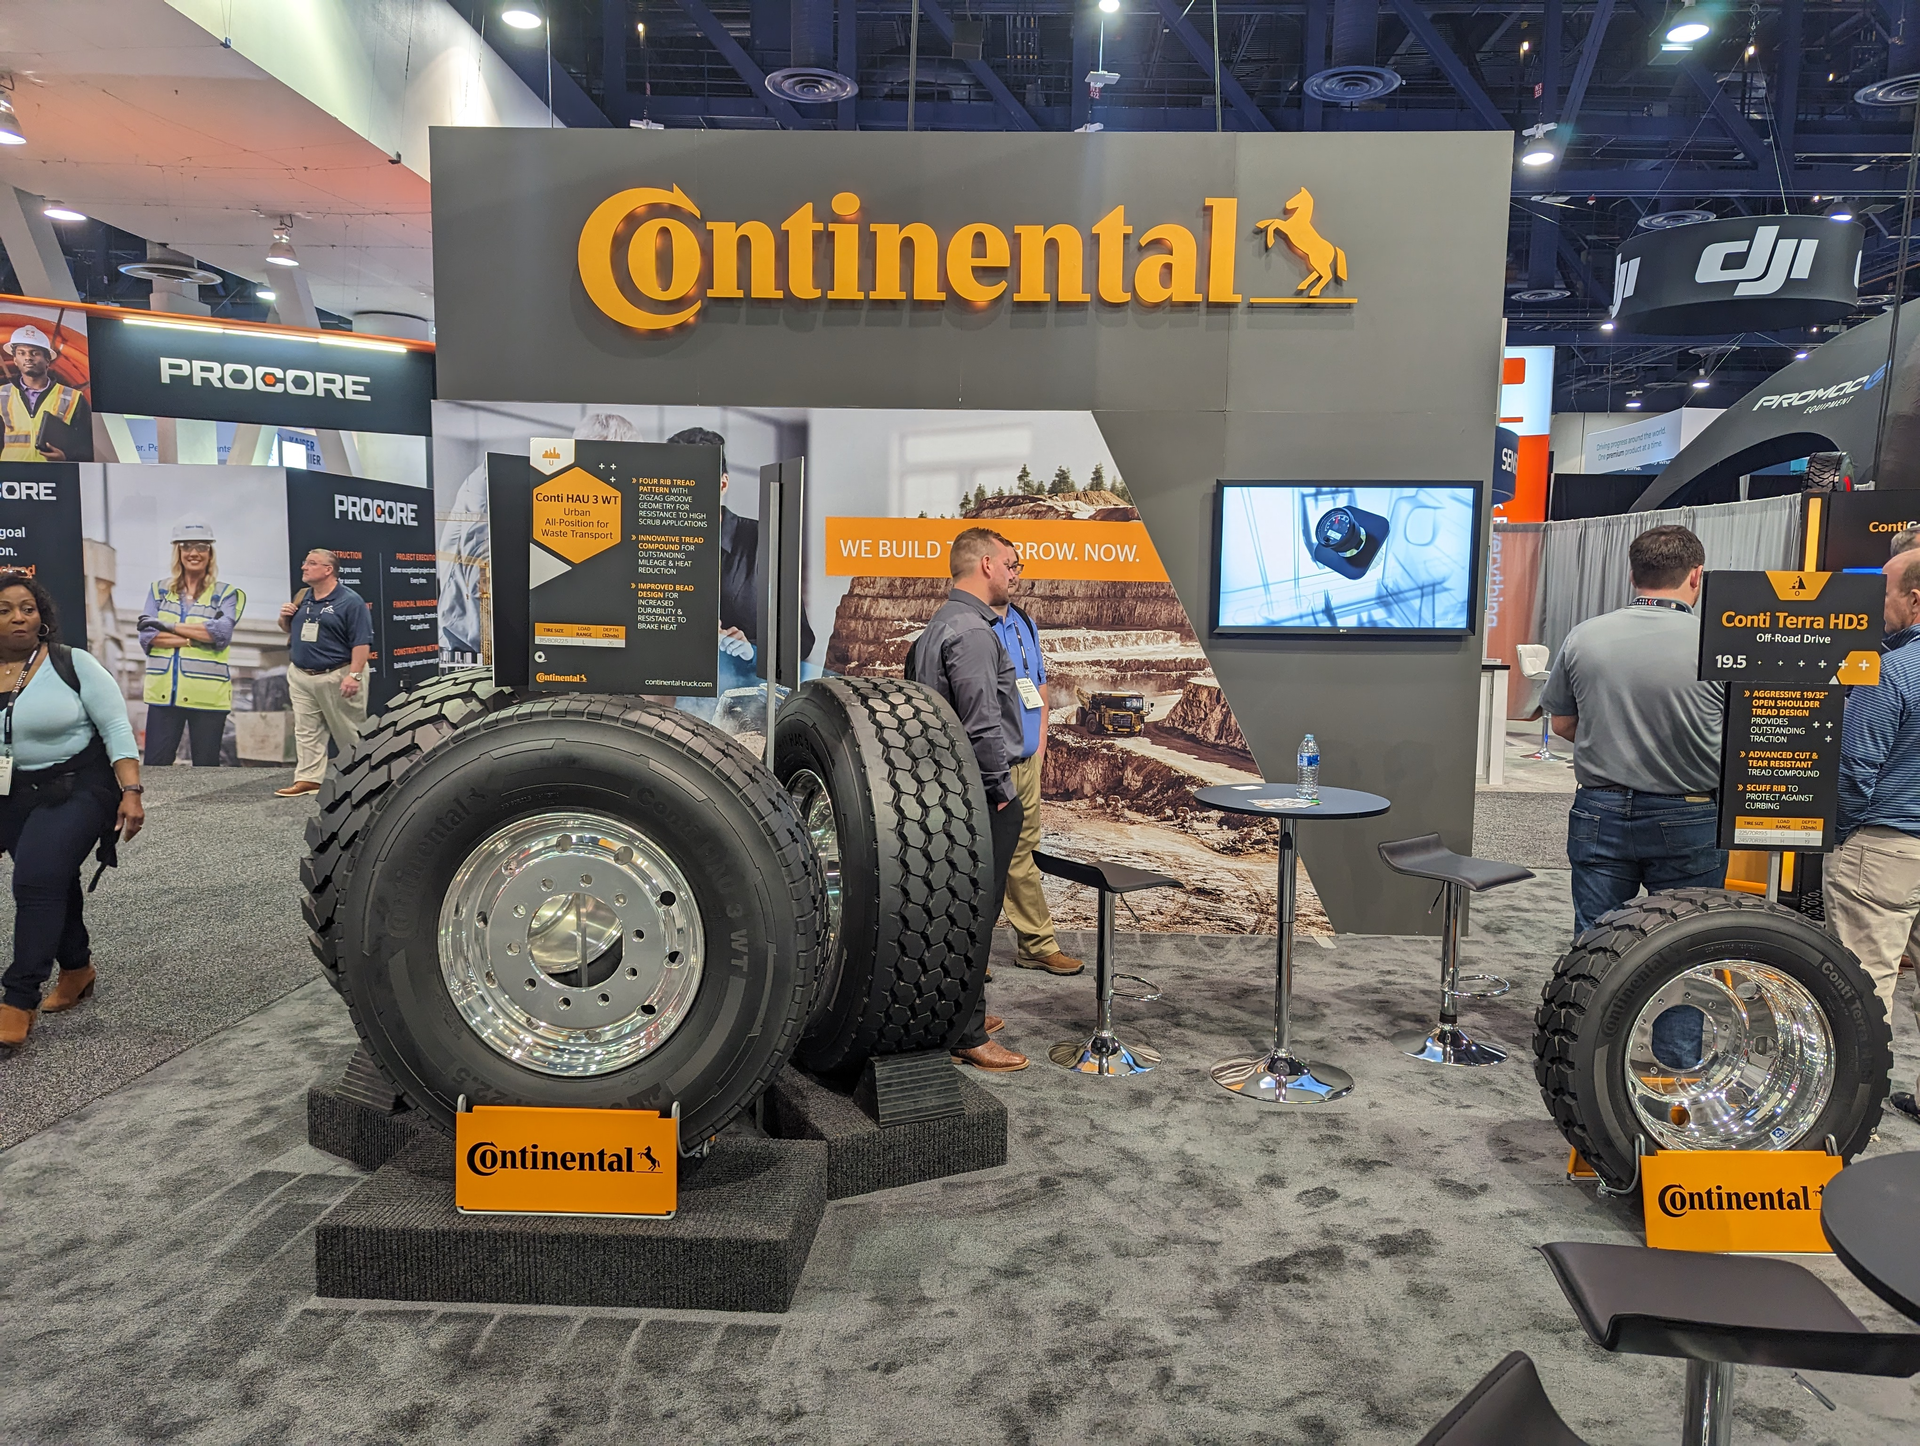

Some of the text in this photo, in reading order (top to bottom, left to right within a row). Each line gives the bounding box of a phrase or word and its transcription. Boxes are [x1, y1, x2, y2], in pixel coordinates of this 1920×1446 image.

[578, 183, 1242, 329] Continental
[160, 357, 371, 401] PROCORE
[1803, 396, 1854, 414] EQUIPMENT
[639, 477, 695, 487] FOUR RIB TREAD
[639, 485, 669, 493] PATTERN
[535, 492, 620, 505] Conti HAU 3 WT
[639, 494, 693, 503] ZIGZAG GROOVE
[334, 494, 419, 526] PROCORE
[638, 502, 690, 511] GEOMETRY FOR
[563, 507, 591, 517] Urban
[638, 510, 677, 518] RESISTANCE
[689, 512, 707, 520] HIGH
[545, 518, 610, 528] All-Position for
[638, 518, 708, 528] SCRUB APPLICATIONS
[541, 528, 613, 540] Waste Transport
[638, 535, 704, 544] INNOVATIVE TREAD
[638, 543, 680, 551] COMPOUND
[839, 539, 873, 558] WE
[878, 539, 941, 559] BUILD
[1084, 543, 1141, 563] NOW.
[396, 552, 436, 561] PROJECT EXECUTIO
[638, 551, 686, 559] OUTSTANDING
[638, 567, 677, 575] REDUCTION
[638, 583, 695, 592] IMPROVED BEAD
[393, 600, 416, 608] FINANCIAL
[637, 599, 674, 607] INCREASED
[637, 607, 676, 615] DURABILITY
[637, 615, 687, 624] RESISTANCE TO
[1721, 610, 1869, 630] Conti Terra HD3
[1756, 633, 1831, 644] Off-Road Drive
[393, 645, 427, 656] CONSTRUCTION
[1715, 655, 1746, 668] 19.5
[536, 672, 580, 683] Continental
[645, 679, 713, 688] continental-truck.com
[1753, 690, 1801, 698] AGGRESSIVE
[1752, 699, 1820, 708] OPEN SHOULDER
[1752, 708, 1778, 716] TREAD
[1751, 717, 1789, 725] PROVIDES
[1750, 726, 1806, 735] OUTSTANDING
[1750, 735, 1787, 743] TRACTION
[1748, 751, 1792, 759] ADVANCED
[1812, 752, 1819, 760] &
[1770, 760, 1812, 768] RESISTANT
[1747, 768, 1820, 777] TREAD COMPOUND
[1787, 785, 1799, 793] TO
[1746, 793, 1814, 802] PROTECT AGAINST
[1745, 802, 1780, 810] CURBING
[725, 902, 743, 918] 3
[730, 928, 749, 972] WT
[1821, 961, 1855, 1000] Conti
[1600, 952, 1669, 1038] Continental
[466, 1140, 636, 1176] Continental
[1658, 1183, 1812, 1218] Continental
